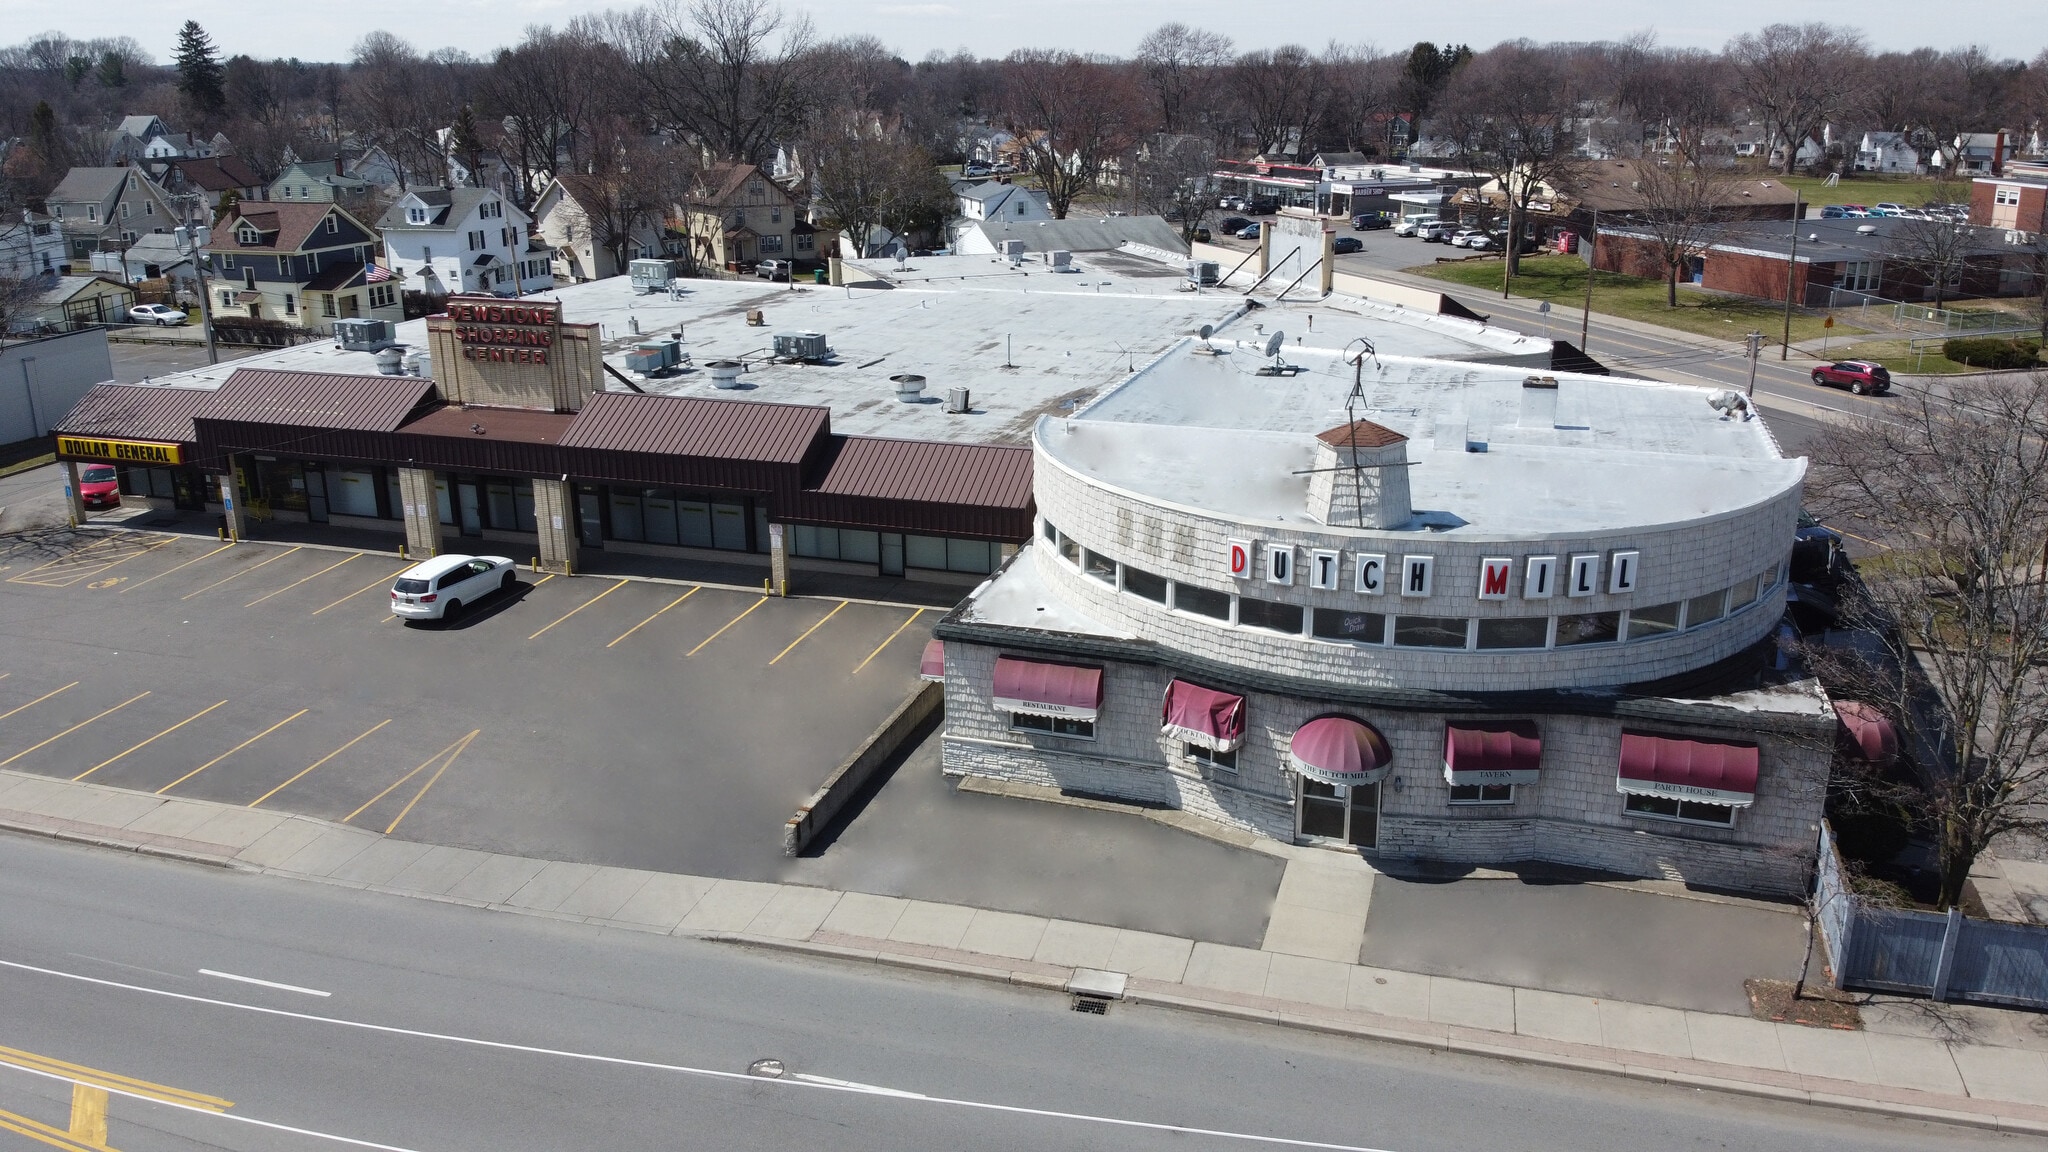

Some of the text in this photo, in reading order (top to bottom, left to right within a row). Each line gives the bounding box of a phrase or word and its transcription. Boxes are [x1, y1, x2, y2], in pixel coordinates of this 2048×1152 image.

[447, 303, 556, 326] DEWSTONE
[455, 325, 553, 347] SHOPPING
[463, 346, 549, 366] CENTER
[64, 439, 171, 462] DOLLAR GENERAL
[1231, 544, 1630, 595] DUTCH MILL
[1022, 701, 1066, 712] RESTAURANT
[1304, 763, 1316, 773] THE
[1318, 769, 1348, 779] DUTCH
[1480, 770, 1512, 778] TAVERN
[1654, 782, 1718, 797] PARTY HOUSE
